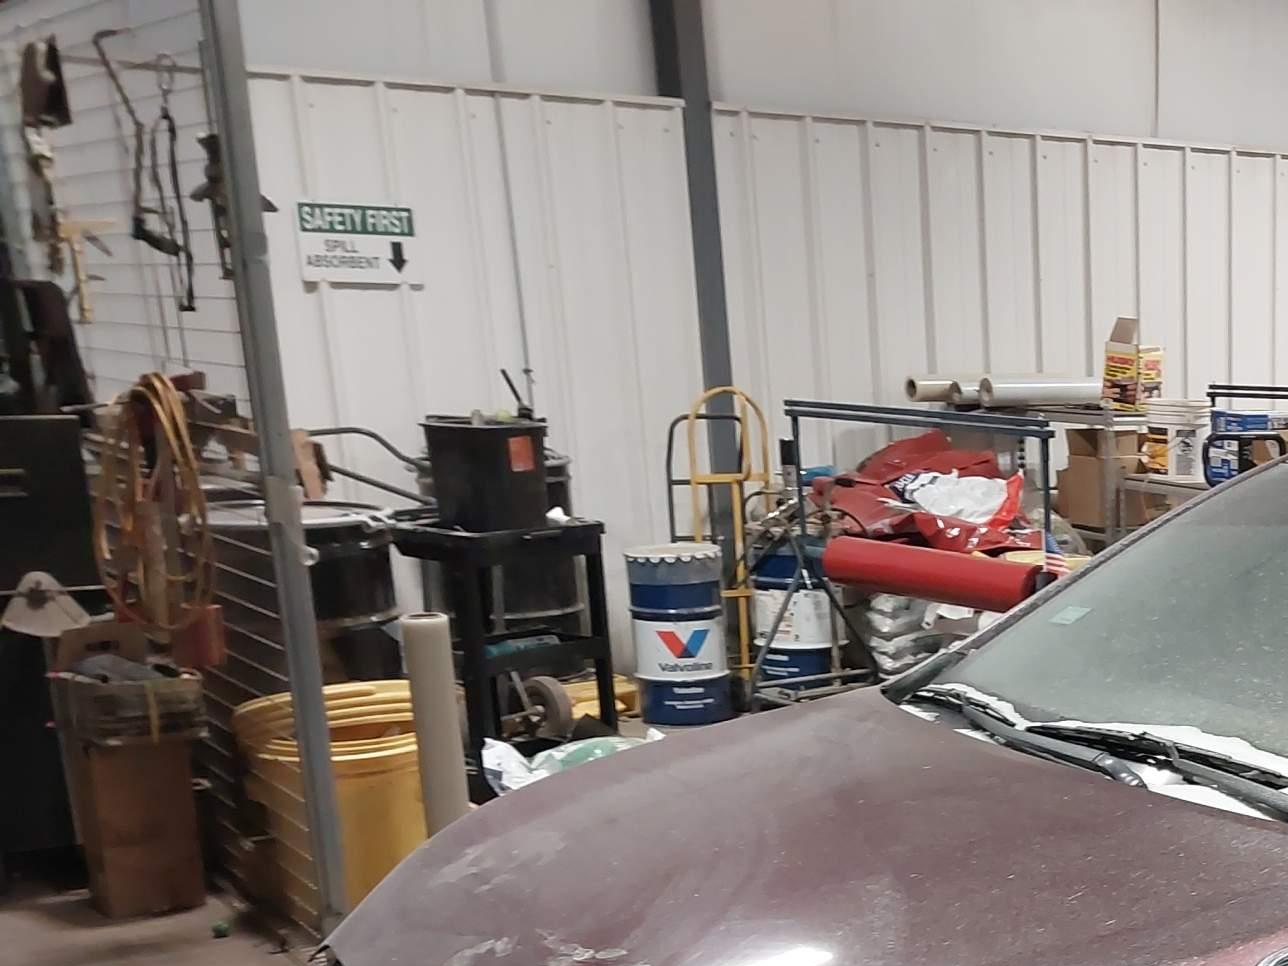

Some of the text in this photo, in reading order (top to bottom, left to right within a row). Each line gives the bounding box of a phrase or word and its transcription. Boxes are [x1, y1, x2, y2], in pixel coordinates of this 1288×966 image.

[301, 205, 410, 234] SAFETY FIRST
[324, 239, 359, 253] SPILL
[306, 254, 380, 269] ABSORBENT
[657, 662, 713, 673] Valvoline
